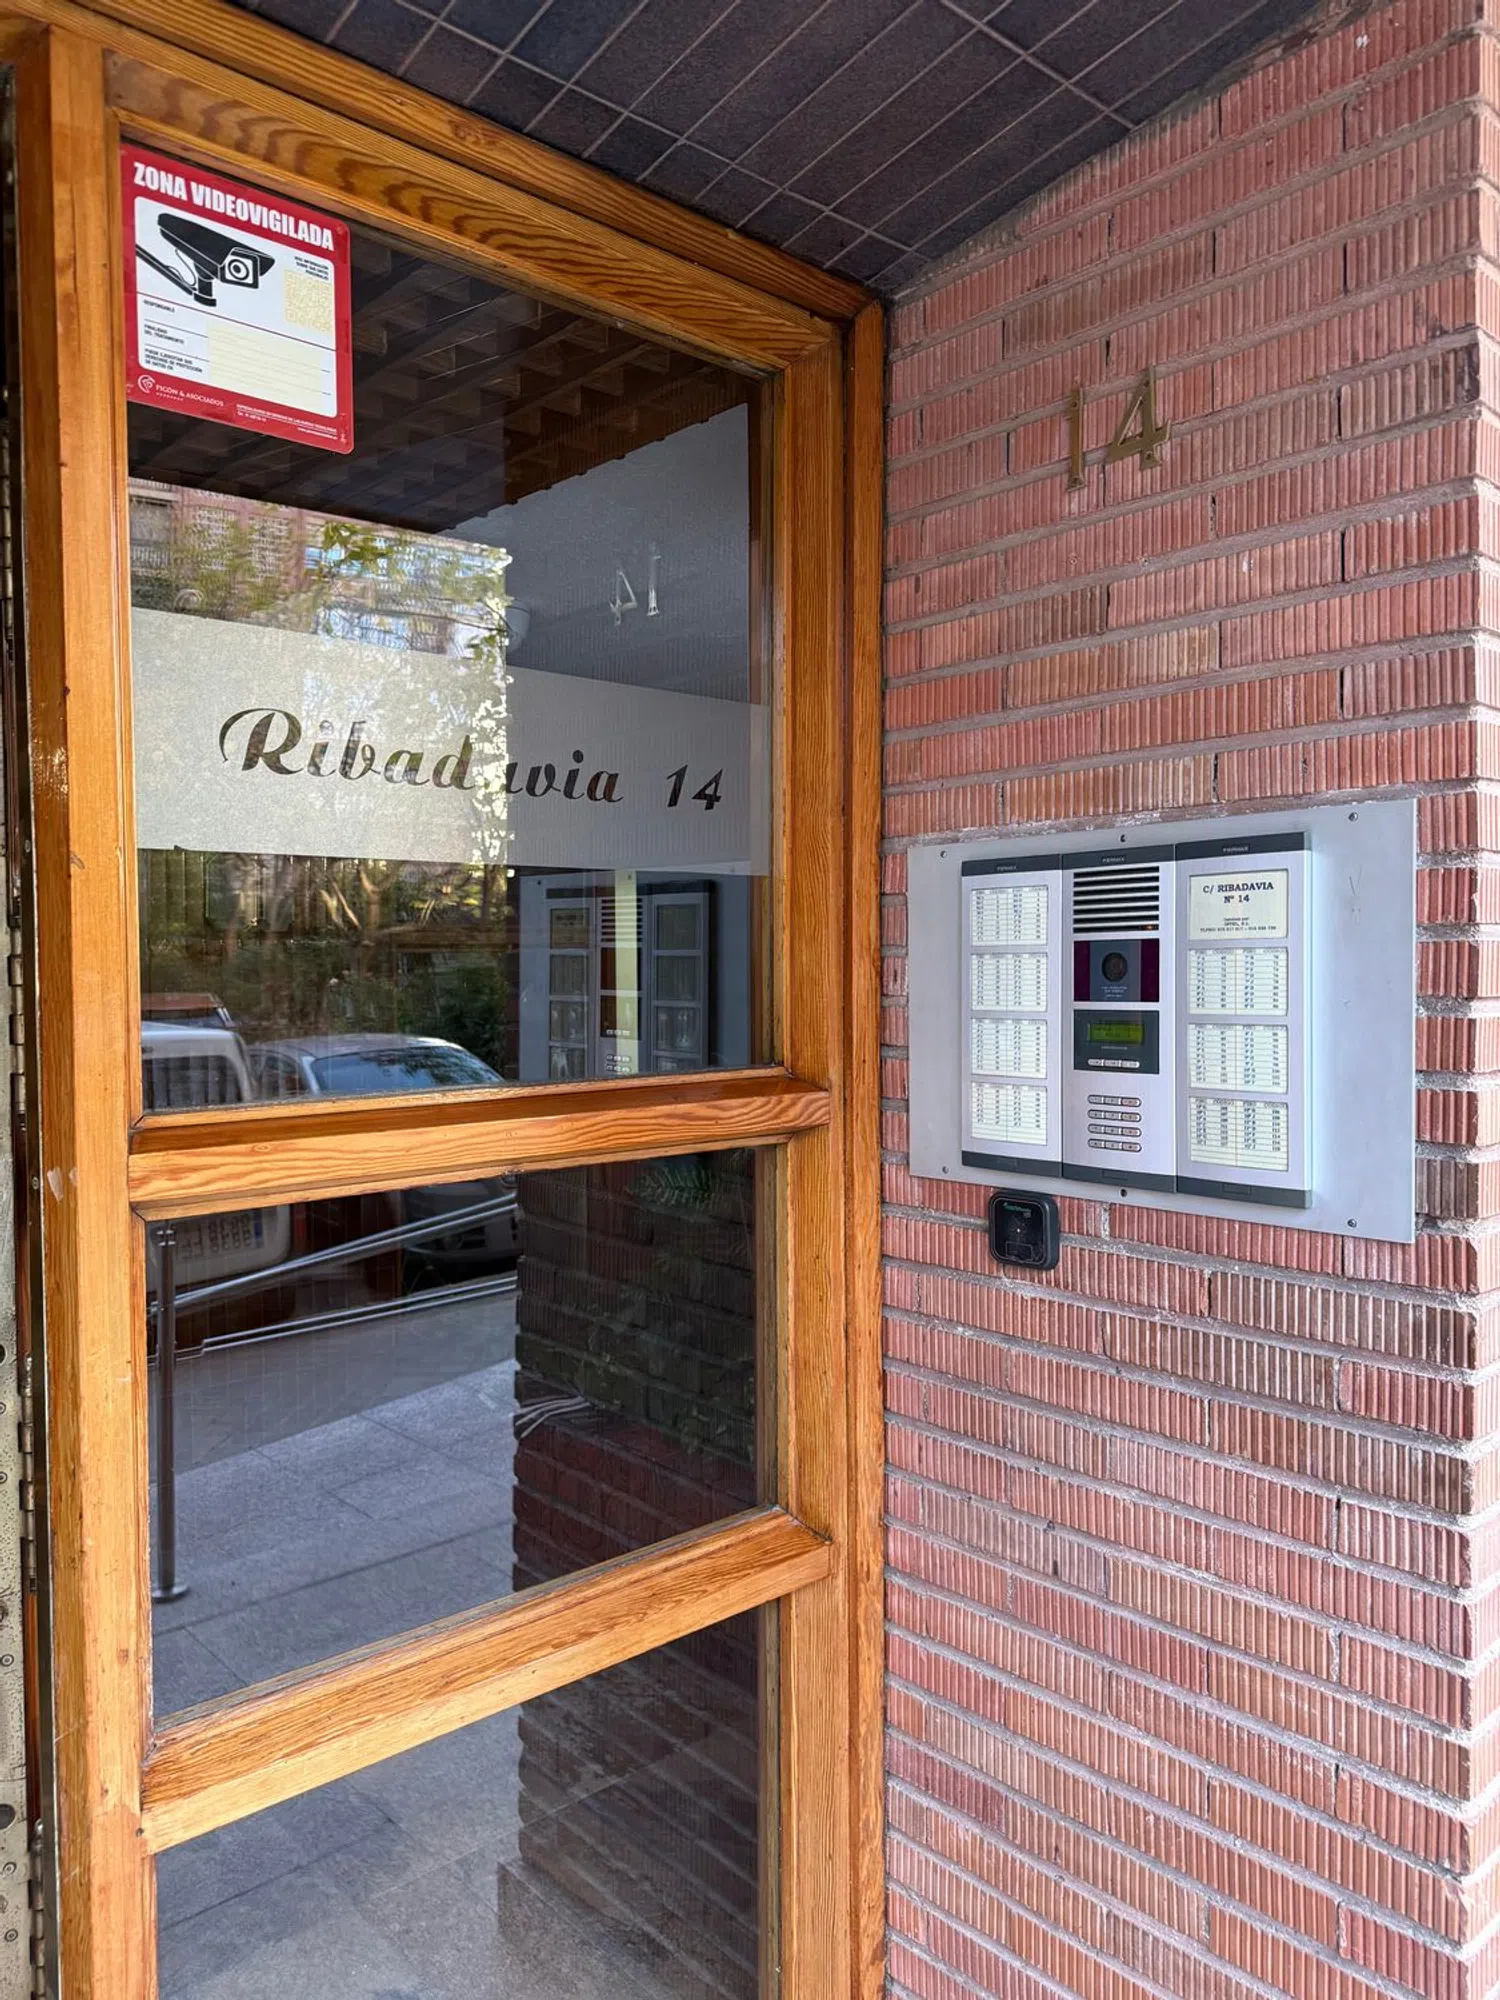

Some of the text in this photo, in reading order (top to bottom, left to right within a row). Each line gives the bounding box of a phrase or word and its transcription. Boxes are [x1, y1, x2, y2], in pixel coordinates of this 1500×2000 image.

[134, 162, 334, 251] ZONA VIDEOVIGILADA
[186, 393, 224, 407] ASOCIADOS
[1066, 365, 1171, 491] 14
[666, 764, 724, 811] 14
[1203, 882, 1274, 894] C/ RIBADAVIA
[1224, 894, 1250, 904] Nº 14
